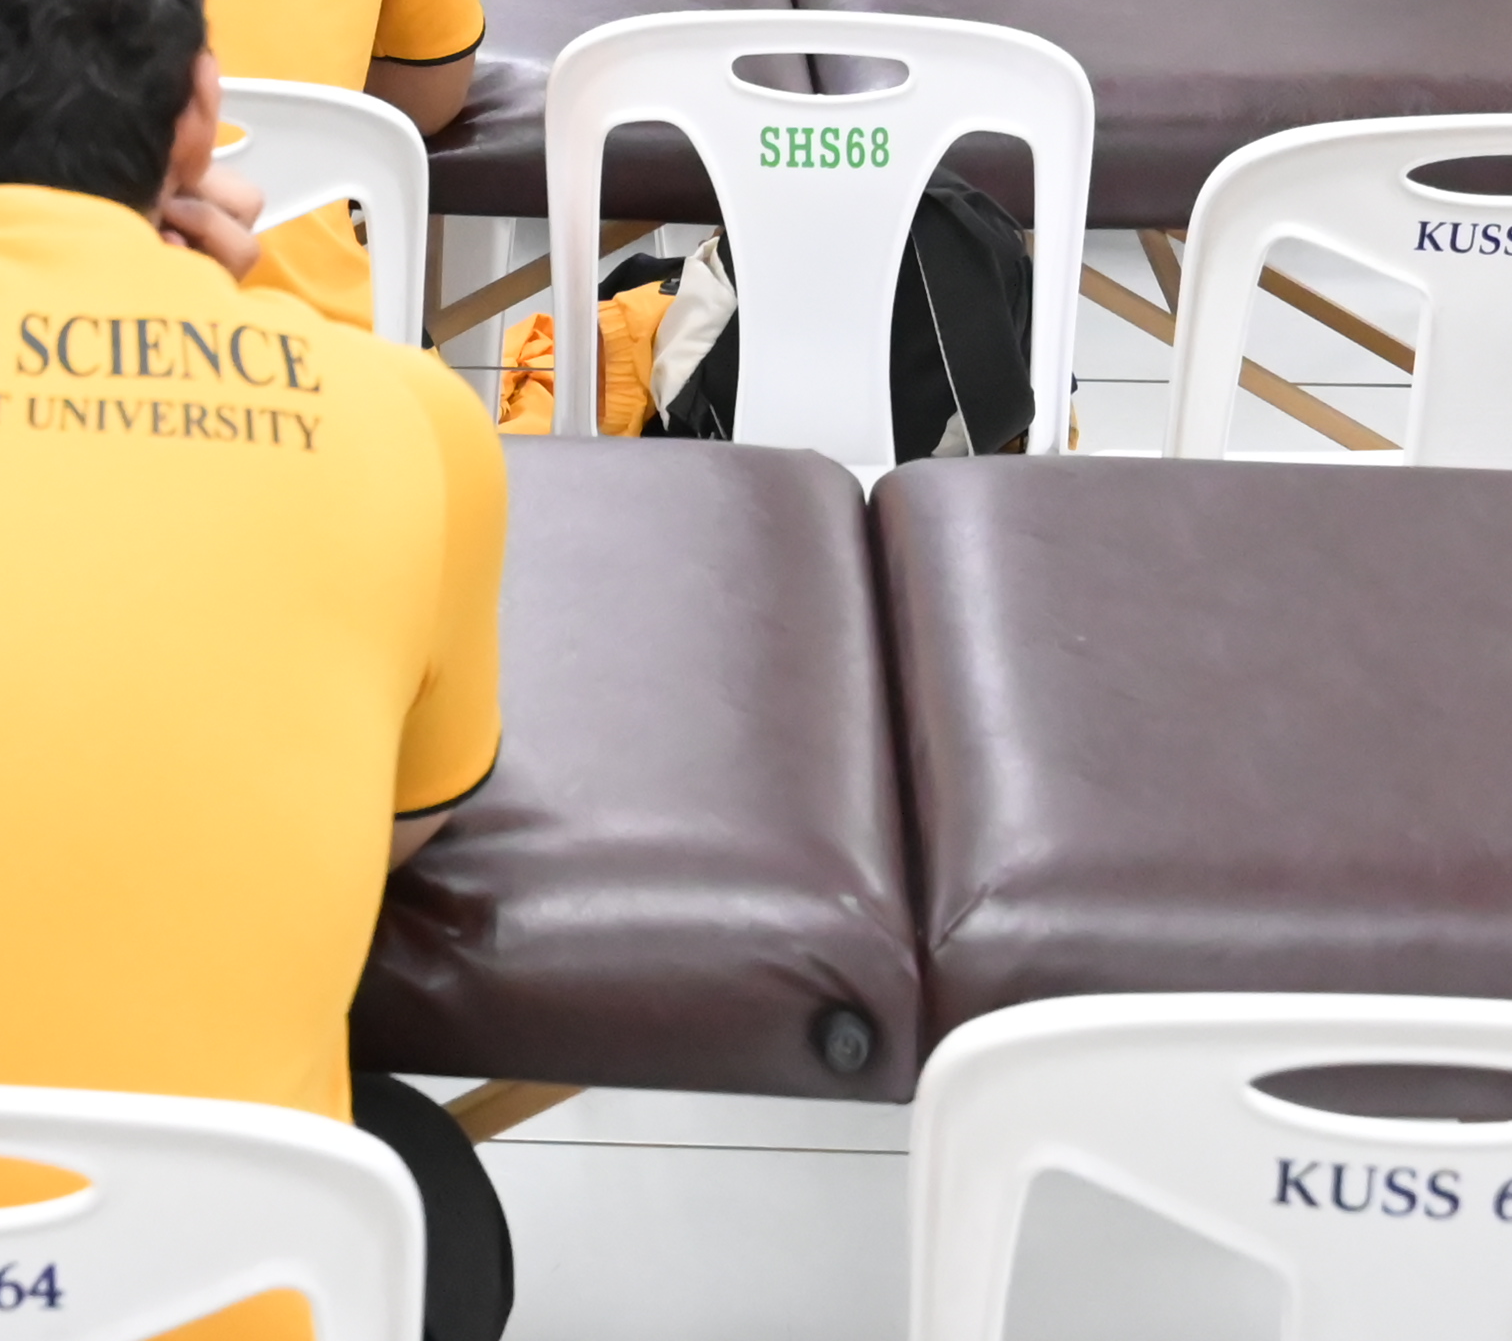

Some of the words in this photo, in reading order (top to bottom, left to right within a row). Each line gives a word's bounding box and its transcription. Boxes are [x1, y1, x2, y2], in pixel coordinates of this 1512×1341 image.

[760, 126, 890, 169] SHS68
[16, 311, 322, 394] SCIENCE
[26, 395, 321, 454] UNIVERSITY
[1273, 1157, 1462, 1220] KUSS
